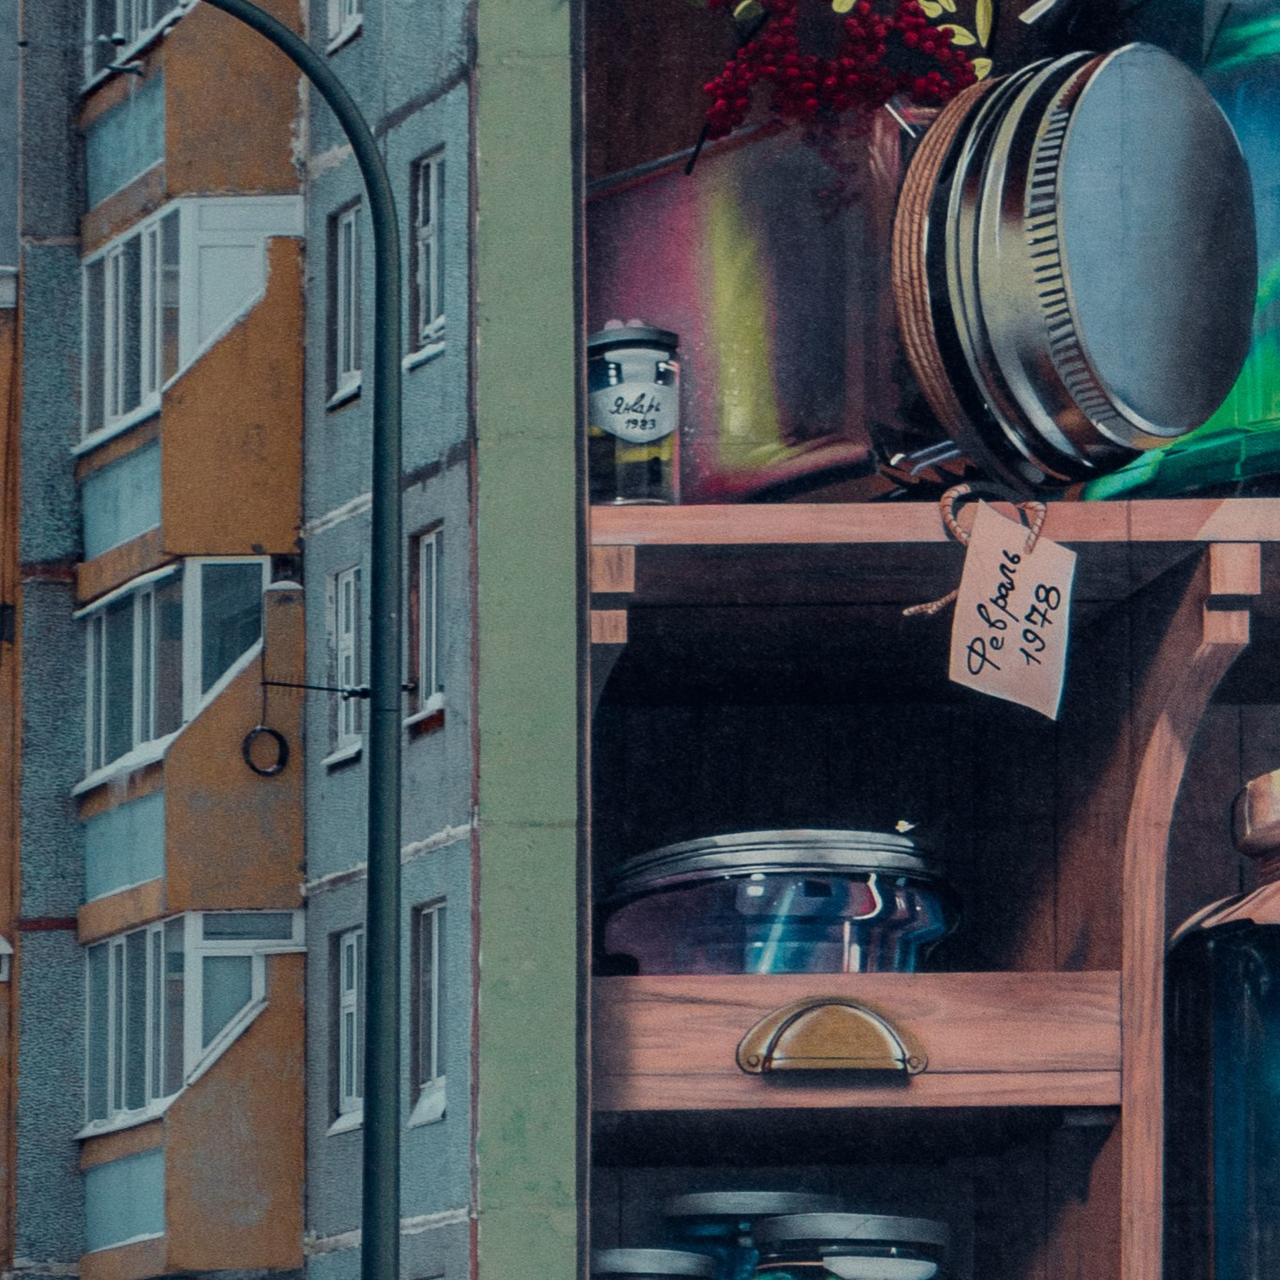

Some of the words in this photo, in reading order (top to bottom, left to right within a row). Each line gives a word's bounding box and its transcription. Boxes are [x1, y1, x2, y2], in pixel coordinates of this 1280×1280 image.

[609, 392, 661, 420] Январь
[966, 549, 1022, 676] Февраль
[1019, 583, 1061, 666] 1978
